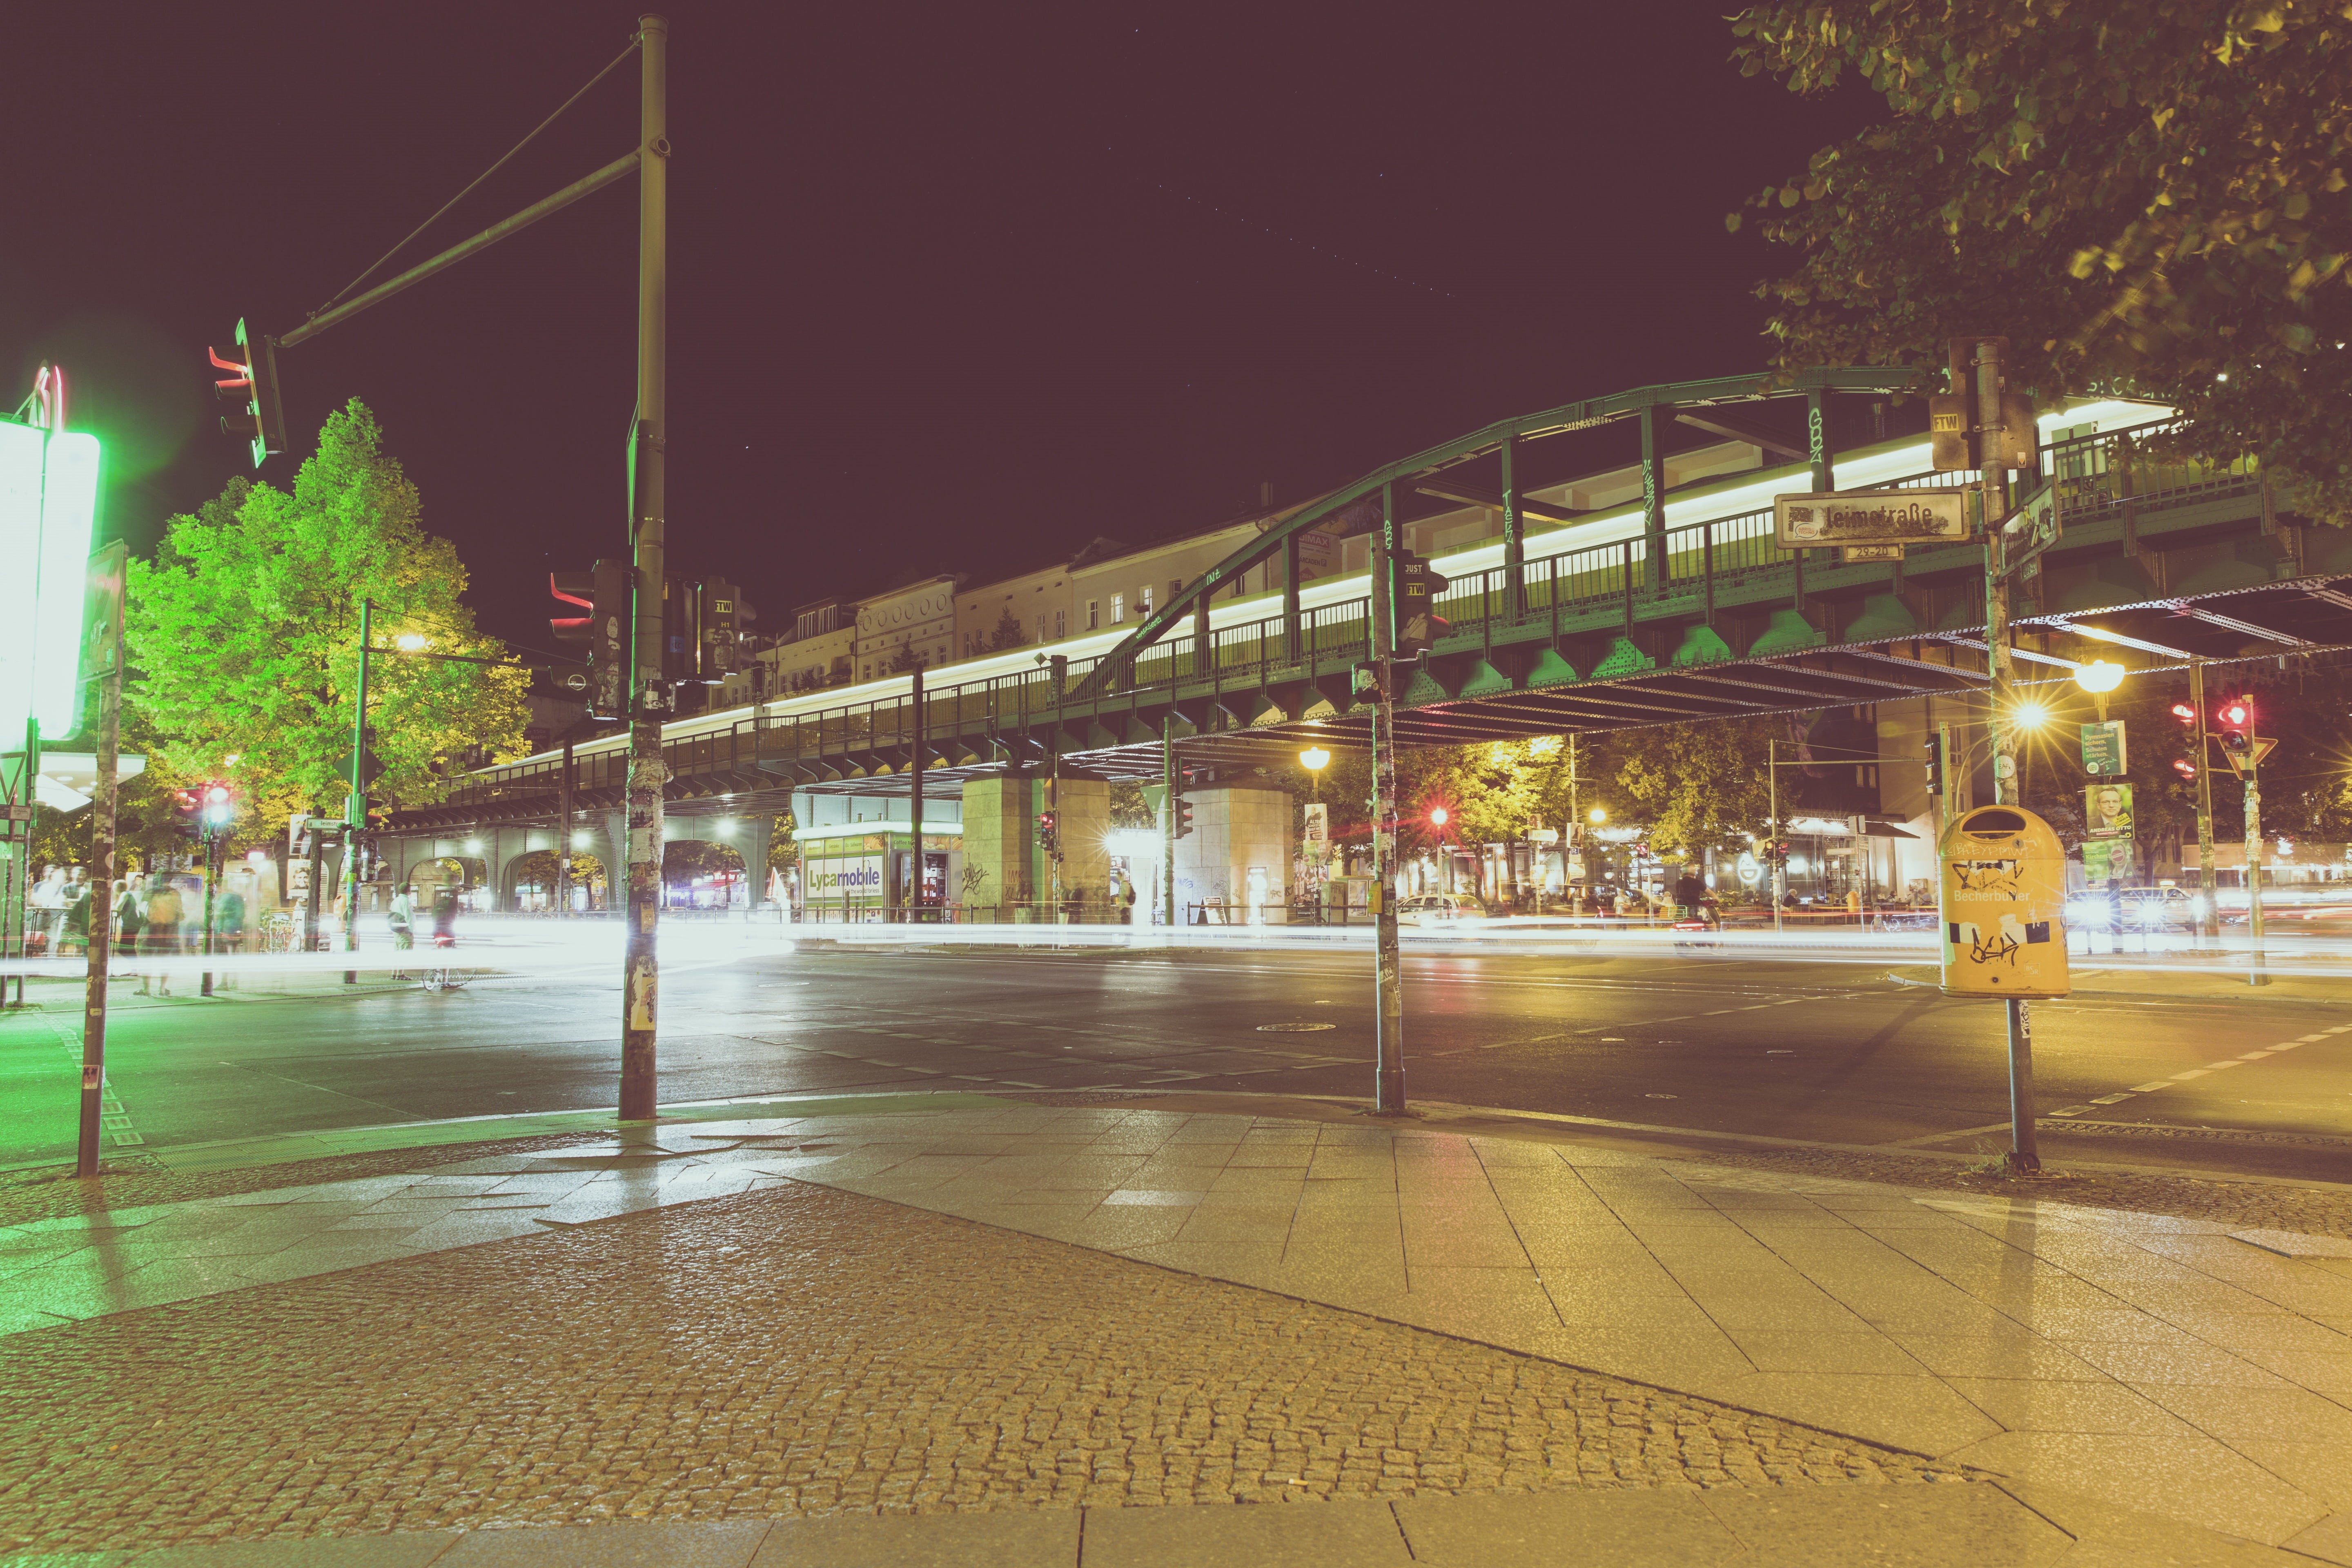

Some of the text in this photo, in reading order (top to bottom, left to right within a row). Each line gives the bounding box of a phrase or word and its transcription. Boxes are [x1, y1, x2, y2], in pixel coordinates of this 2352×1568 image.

[1934, 416, 1957, 429] FTW
[1816, 503, 1932, 528] leimstraße
[1857, 547, 1888, 557] 29-20
[1407, 584, 1423, 594] FTW
[715, 601, 731, 611] FTW
[810, 866, 880, 891] Lycamobile
[1954, 890, 2031, 902] Becherbuer
